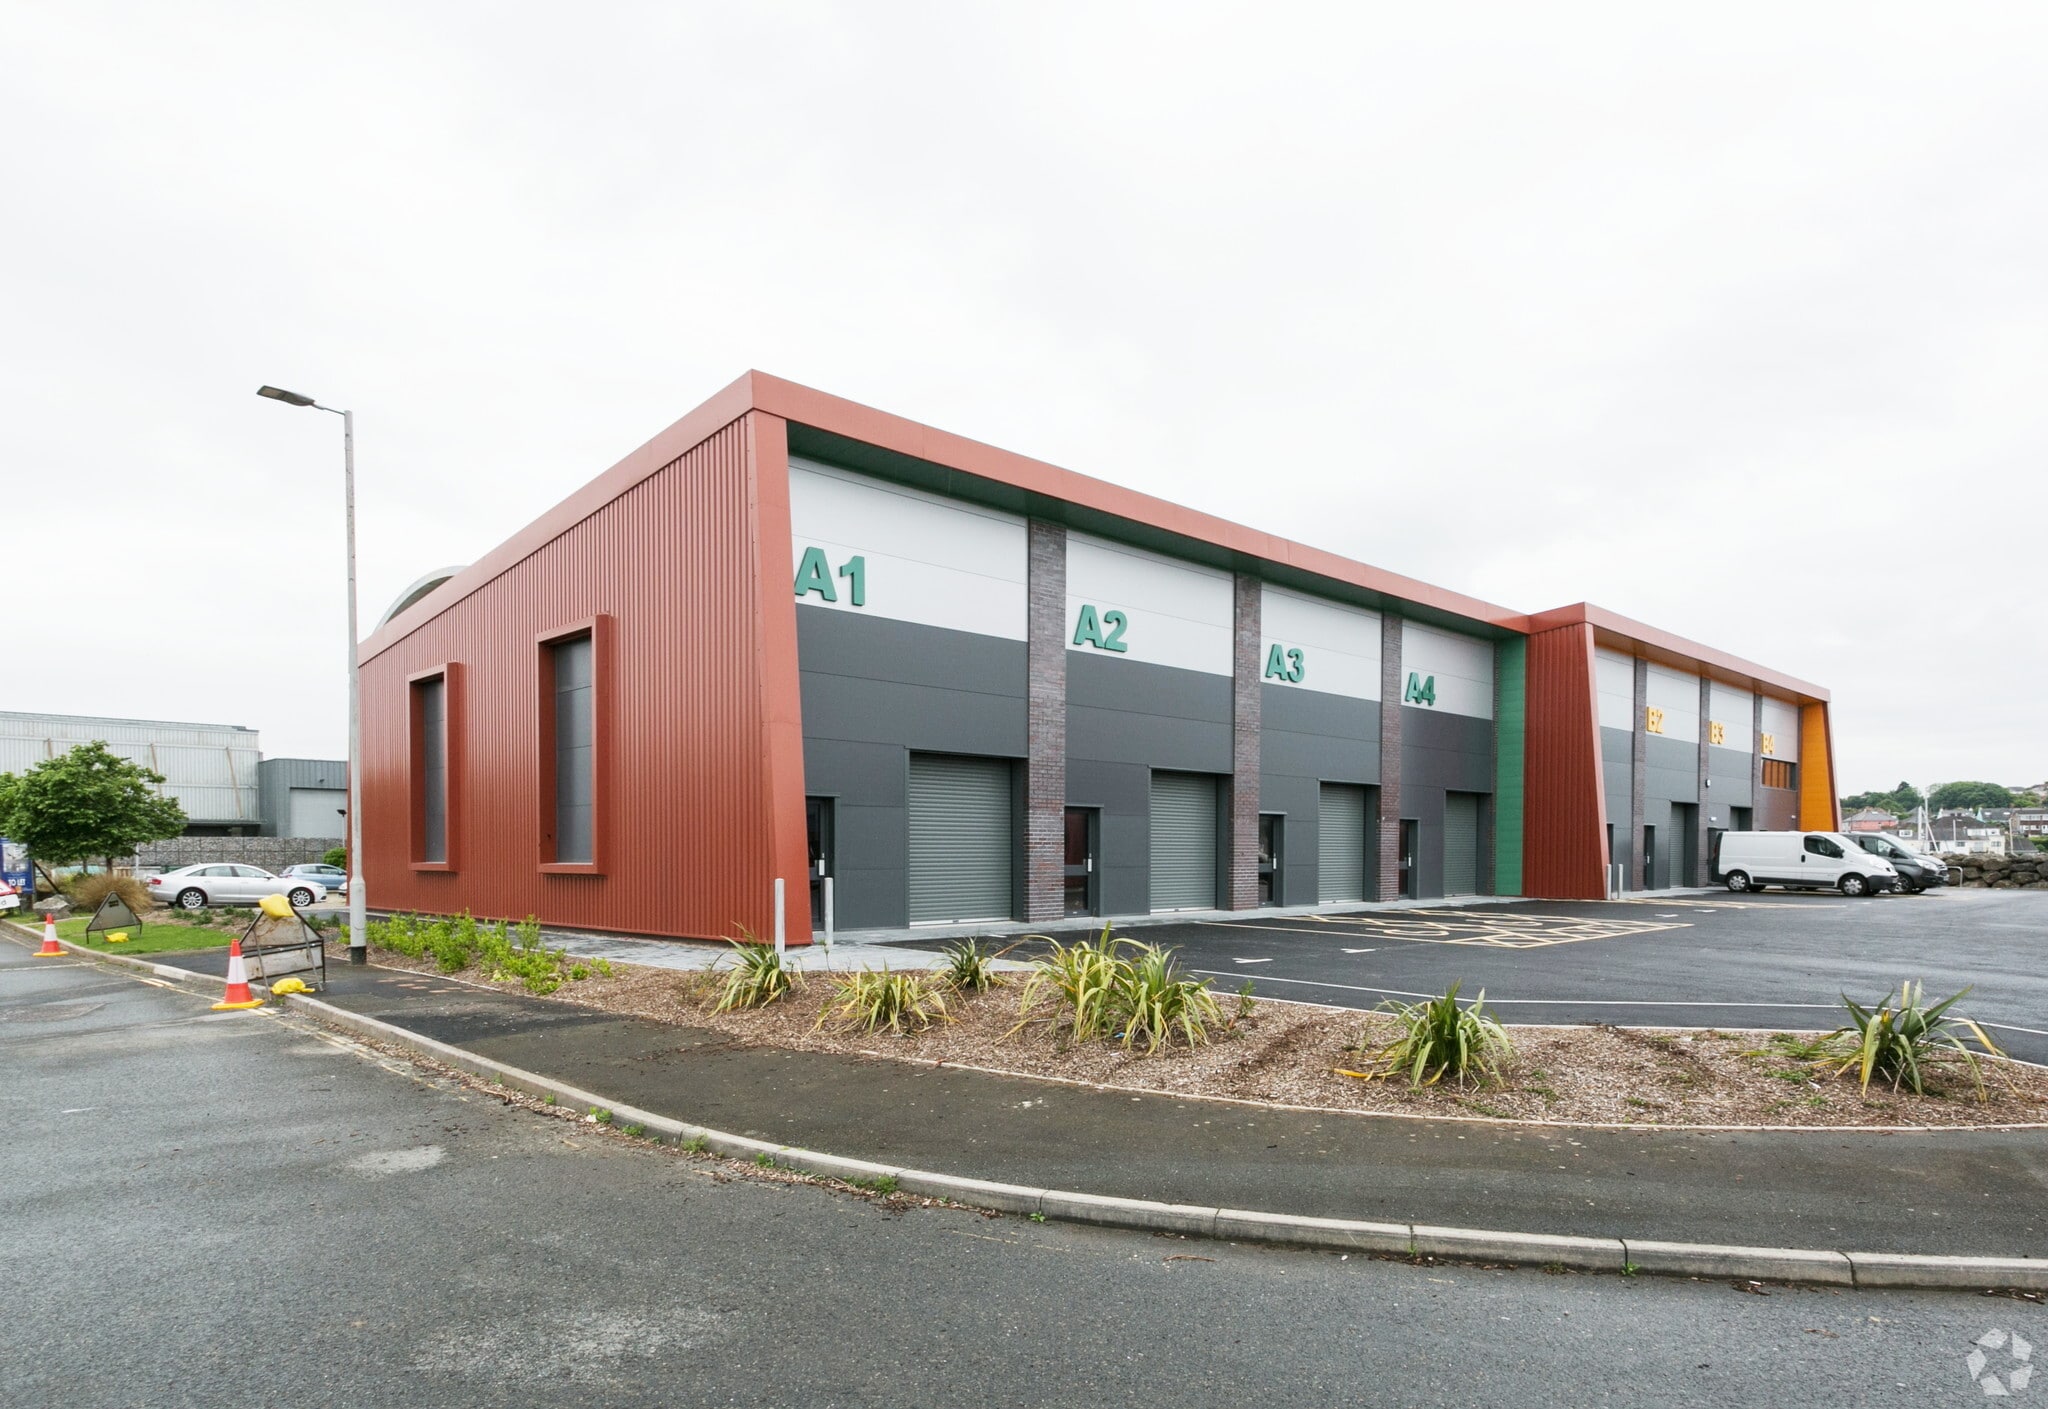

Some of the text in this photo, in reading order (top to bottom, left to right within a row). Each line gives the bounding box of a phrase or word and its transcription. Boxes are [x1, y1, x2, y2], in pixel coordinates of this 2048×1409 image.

[794, 546, 865, 607] A1
[1073, 604, 1128, 653] A2
[1265, 643, 1305, 683] A3
[1405, 672, 1436, 706] A4
[1646, 706, 1664, 734] B2
[1709, 721, 1724, 745] B3
[1761, 733, 1775, 755] B4
